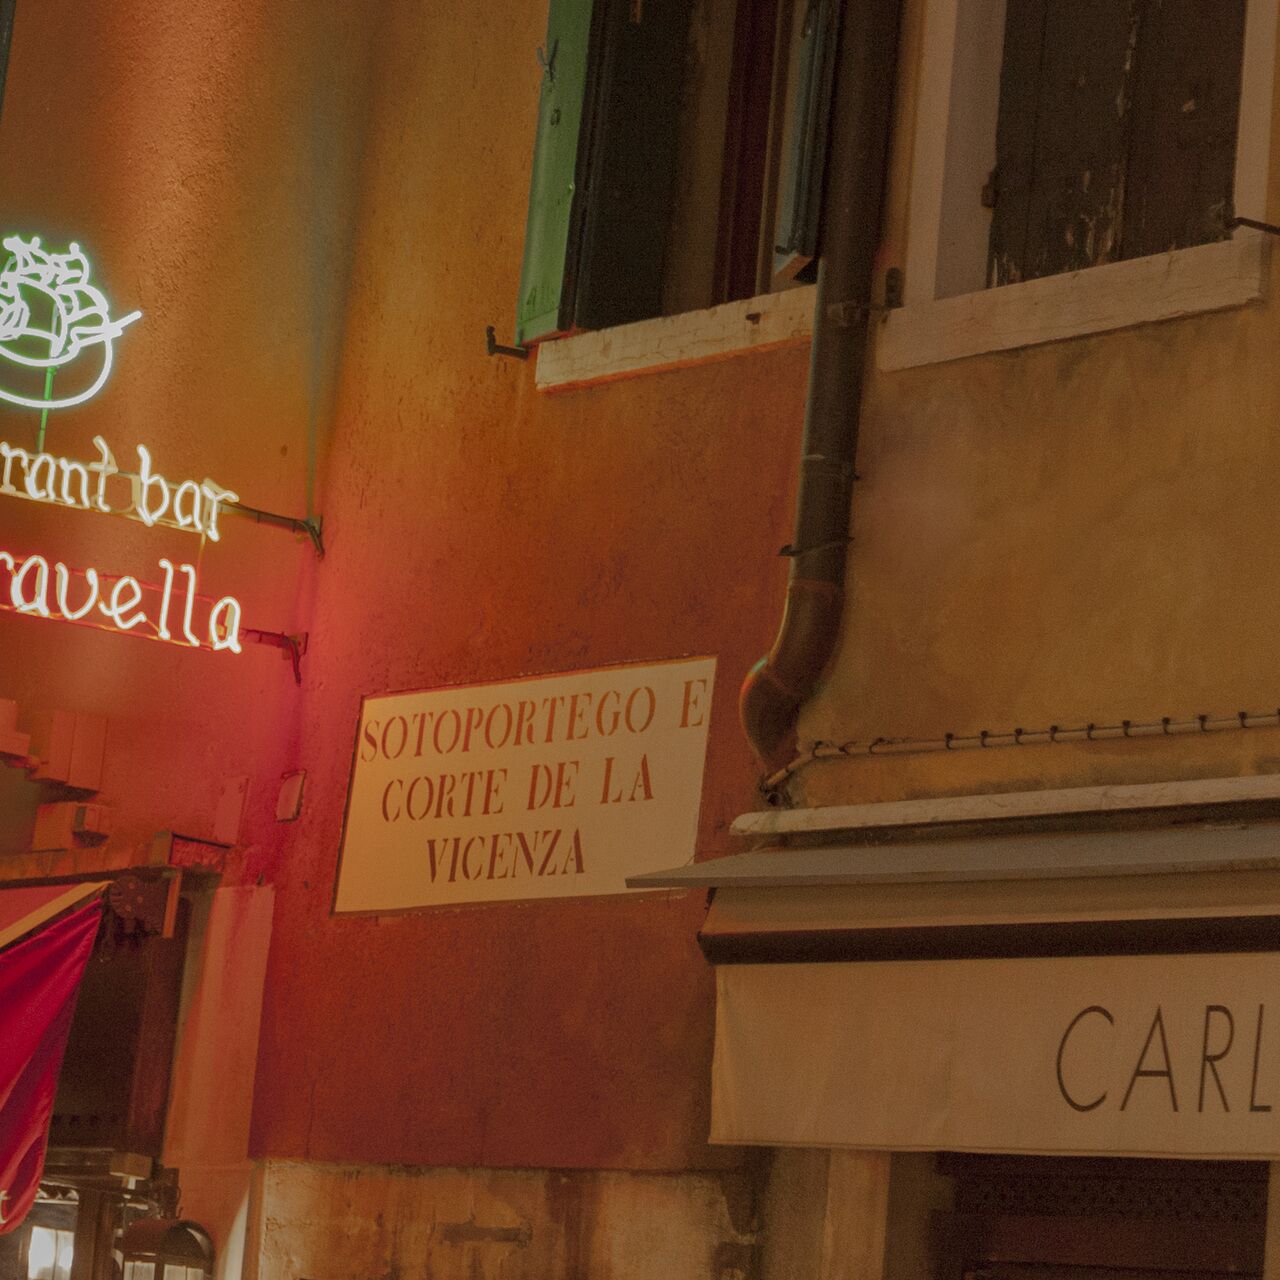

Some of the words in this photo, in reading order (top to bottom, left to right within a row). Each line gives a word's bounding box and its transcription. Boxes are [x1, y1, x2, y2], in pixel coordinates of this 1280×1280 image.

[138, 445, 240, 542] bar
[360, 686, 657, 763] SOTOPORTEGO
[679, 679, 708, 728] E
[382, 768, 508, 822] CORTE
[526, 760, 580, 811] DE
[600, 754, 654, 804] LA
[427, 828, 585, 883] VICENZA
[1056, 1004, 1272, 1113] CARL
